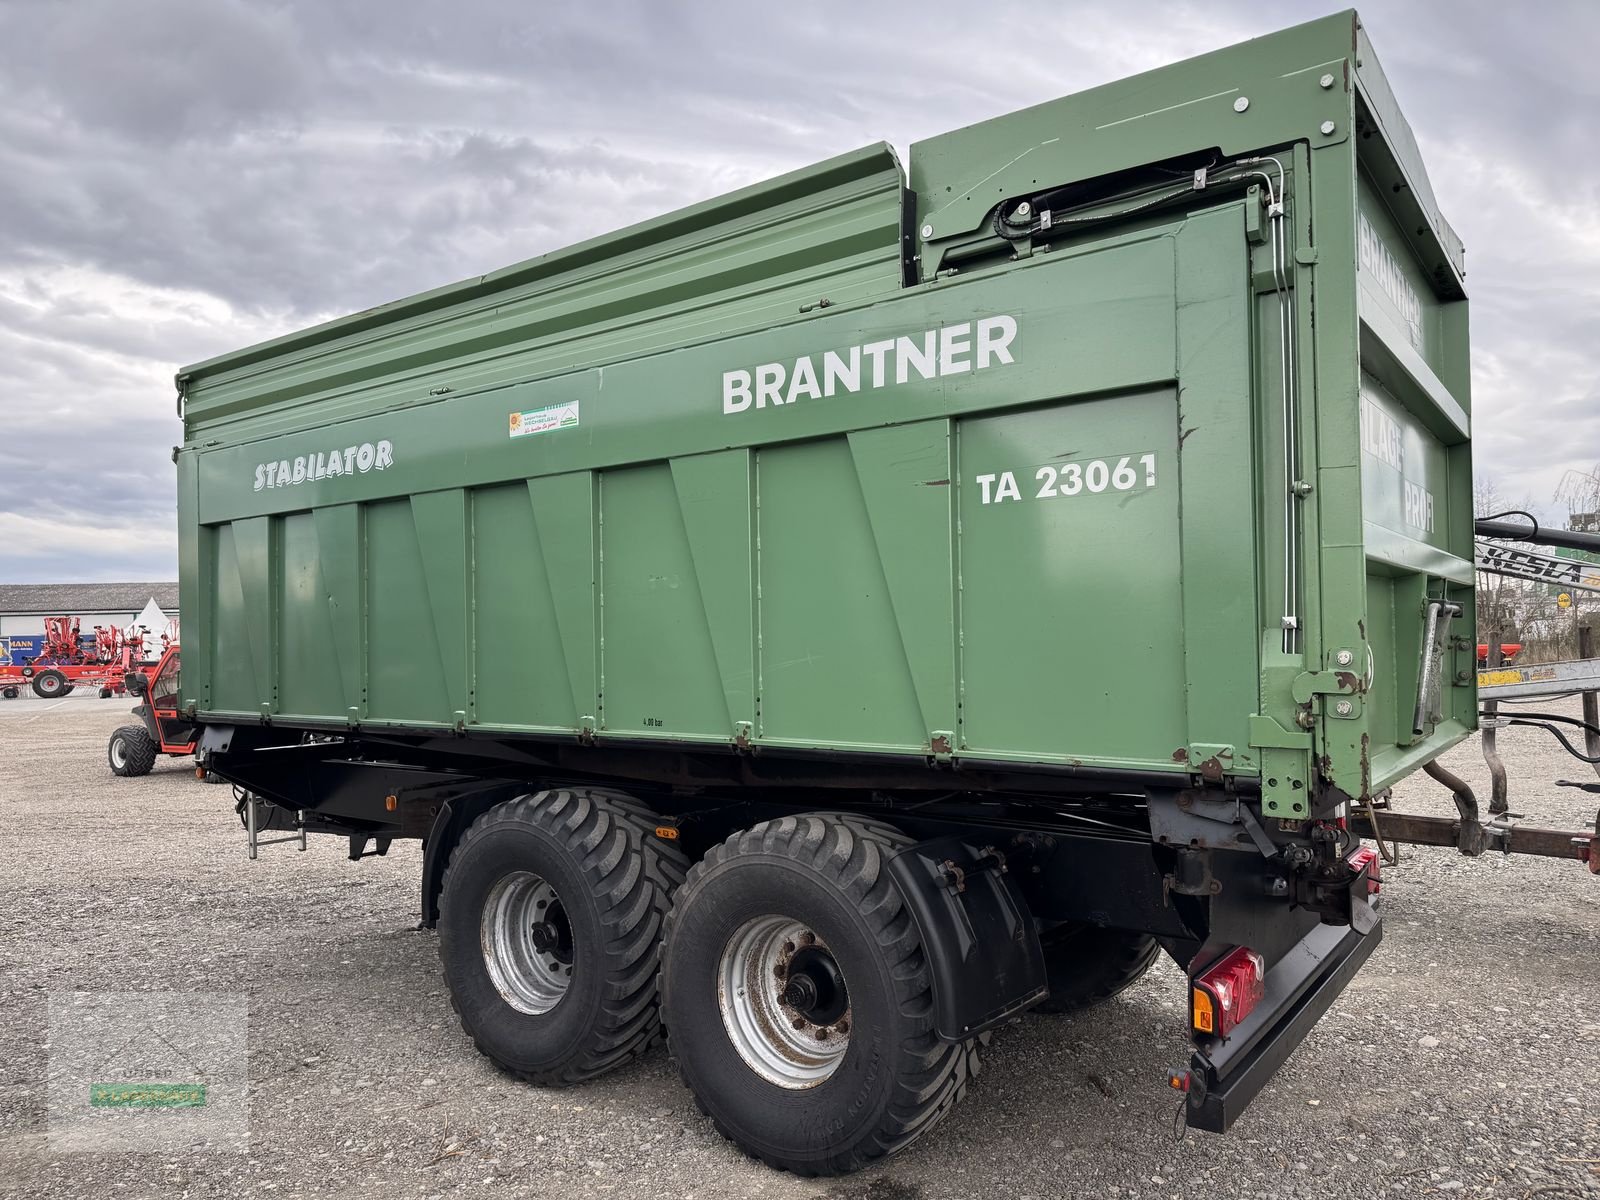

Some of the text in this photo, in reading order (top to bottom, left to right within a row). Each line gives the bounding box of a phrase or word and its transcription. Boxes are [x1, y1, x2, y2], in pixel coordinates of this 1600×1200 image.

[1360, 211, 1421, 338] BRANTNER
[722, 314, 1018, 415] BRANTNER
[253, 439, 394, 492] STABILATOR
[975, 453, 1156, 505] TA 23061
[1404, 479, 1434, 534] PROFI
[1482, 548, 1581, 583] KESLA
